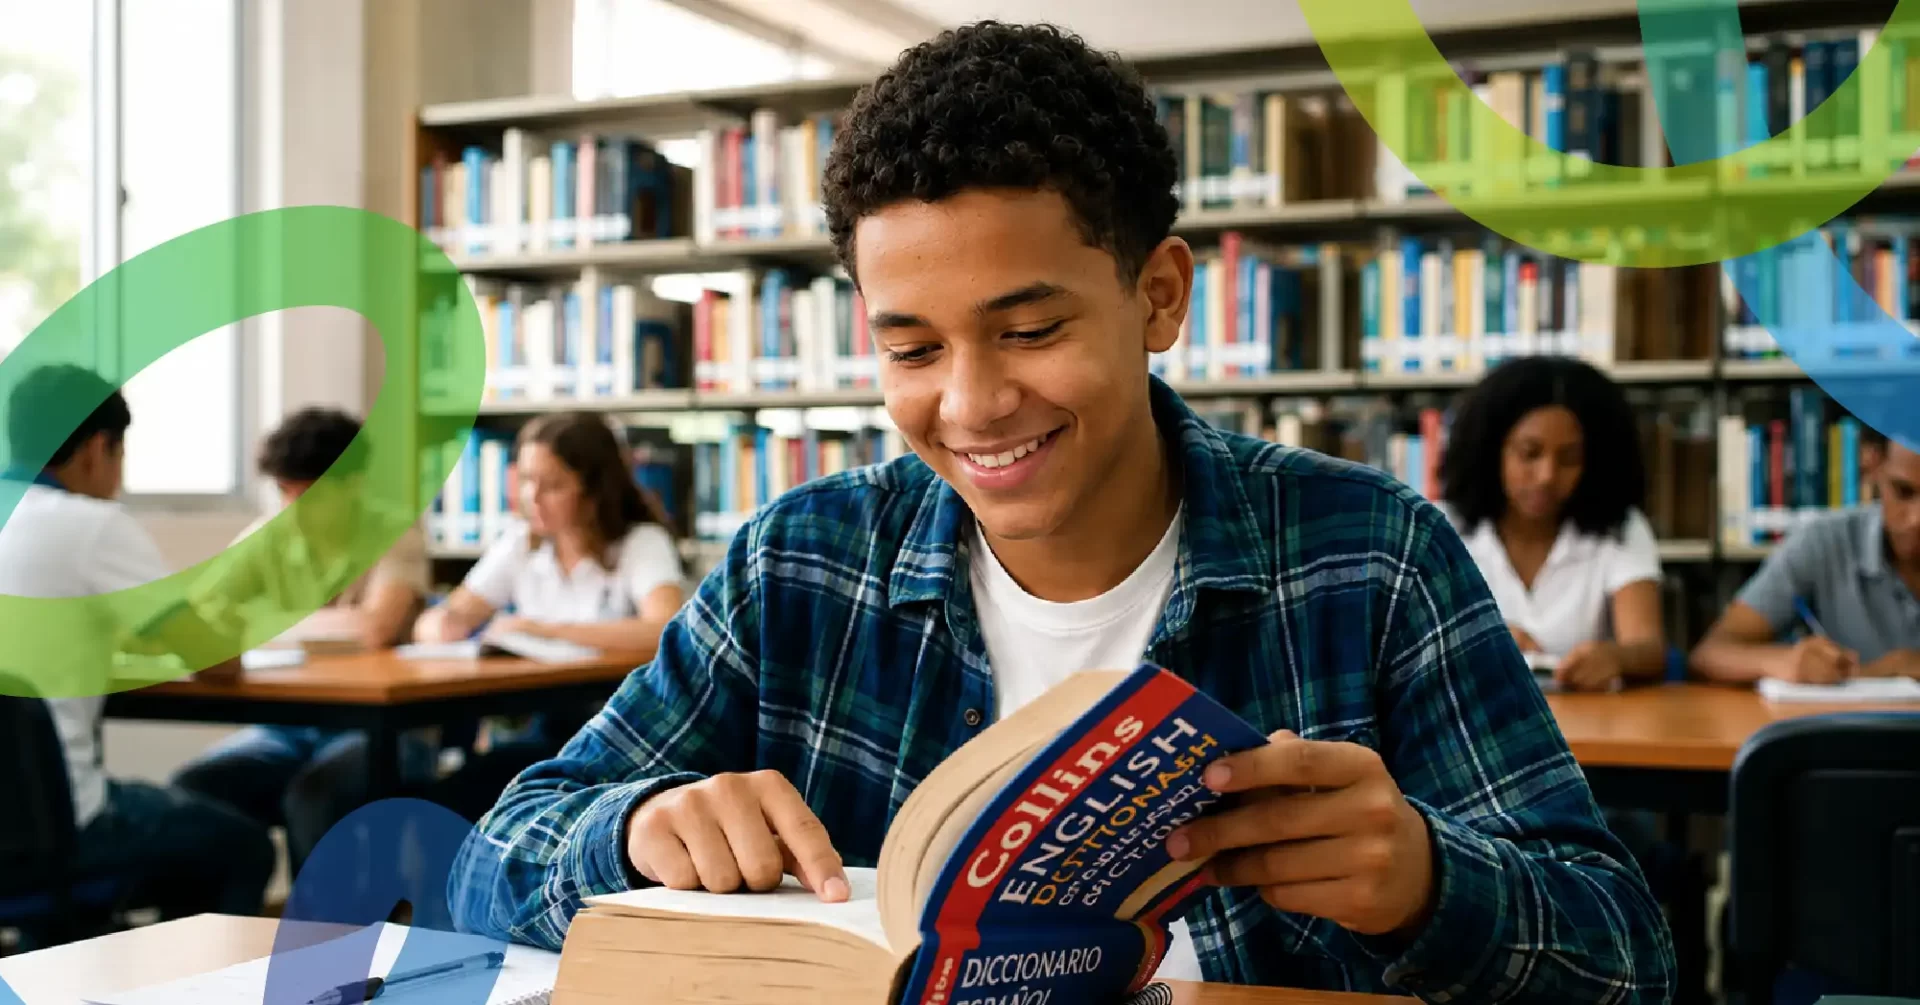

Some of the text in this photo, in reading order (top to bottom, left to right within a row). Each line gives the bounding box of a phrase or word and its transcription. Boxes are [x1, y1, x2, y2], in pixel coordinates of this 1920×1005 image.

[966, 715, 1145, 888] Collins
[999, 717, 1198, 905] ENGLISH
[961, 946, 1102, 989] DICCIONARIO
